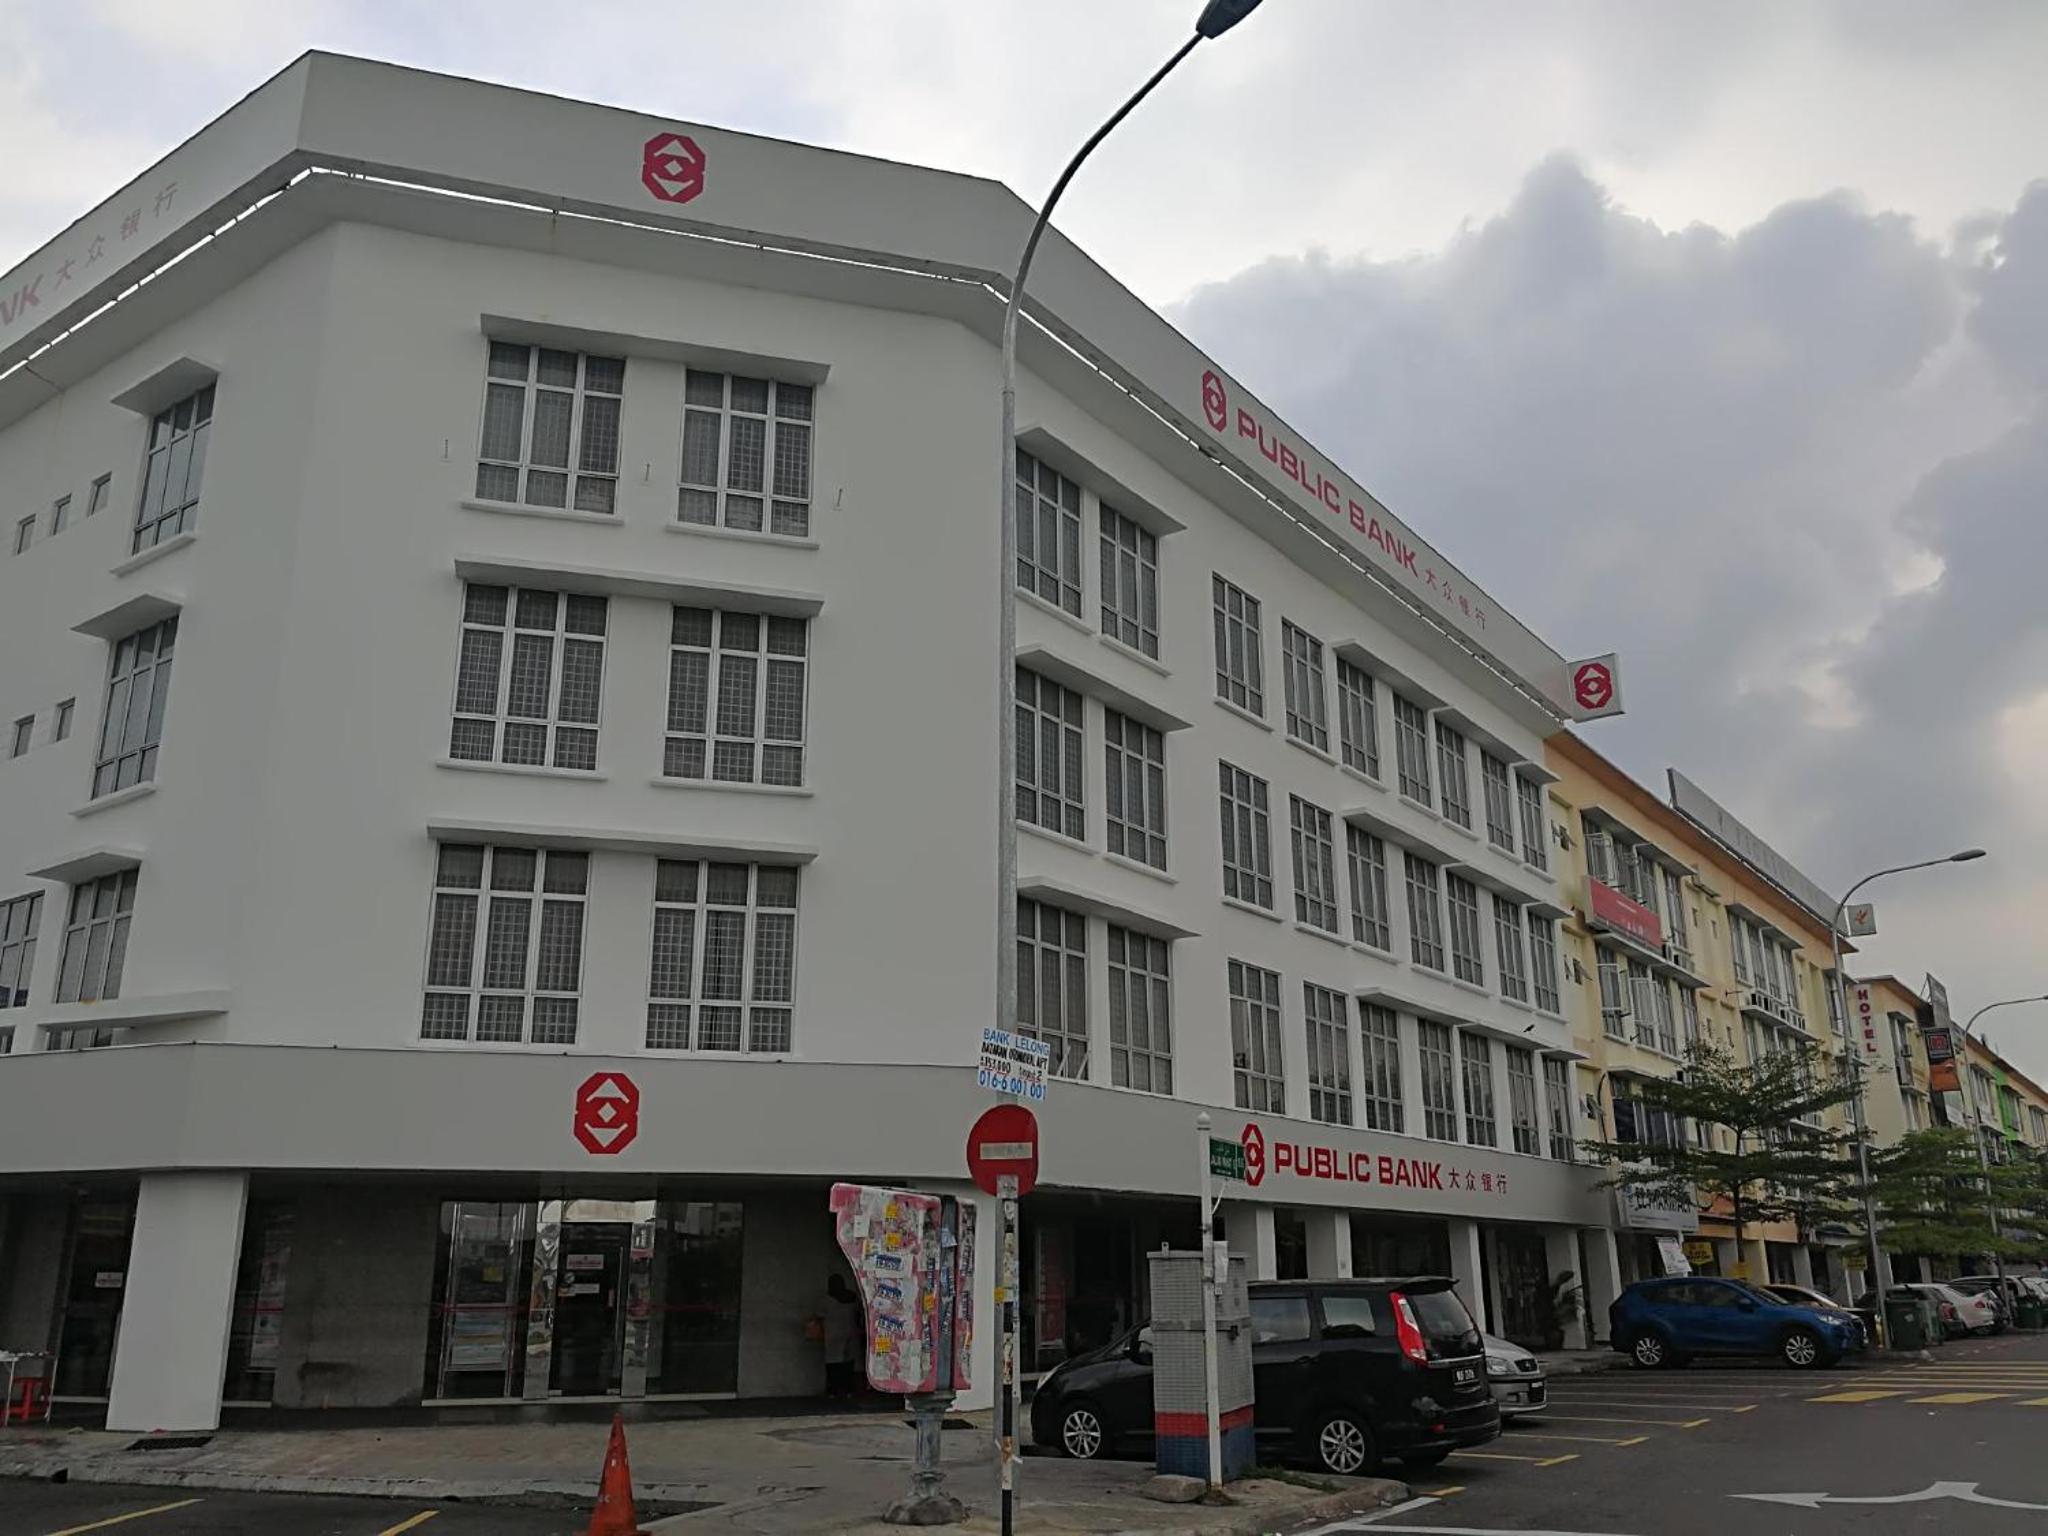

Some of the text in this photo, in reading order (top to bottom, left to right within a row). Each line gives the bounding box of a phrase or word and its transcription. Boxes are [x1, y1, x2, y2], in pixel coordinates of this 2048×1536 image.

[54, 182, 179, 290] 大众银行
[1237, 408, 1418, 578] PUBLIC BANK
[1425, 567, 1487, 632] 大众银行
[983, 1028, 1050, 1056] BANK LELONG
[1857, 989, 1877, 1053] HOTEL
[1274, 1142, 1371, 1183] PUBLIC
[1377, 1155, 1443, 1190] BANK
[1448, 1167, 1507, 1196] 大众银行
